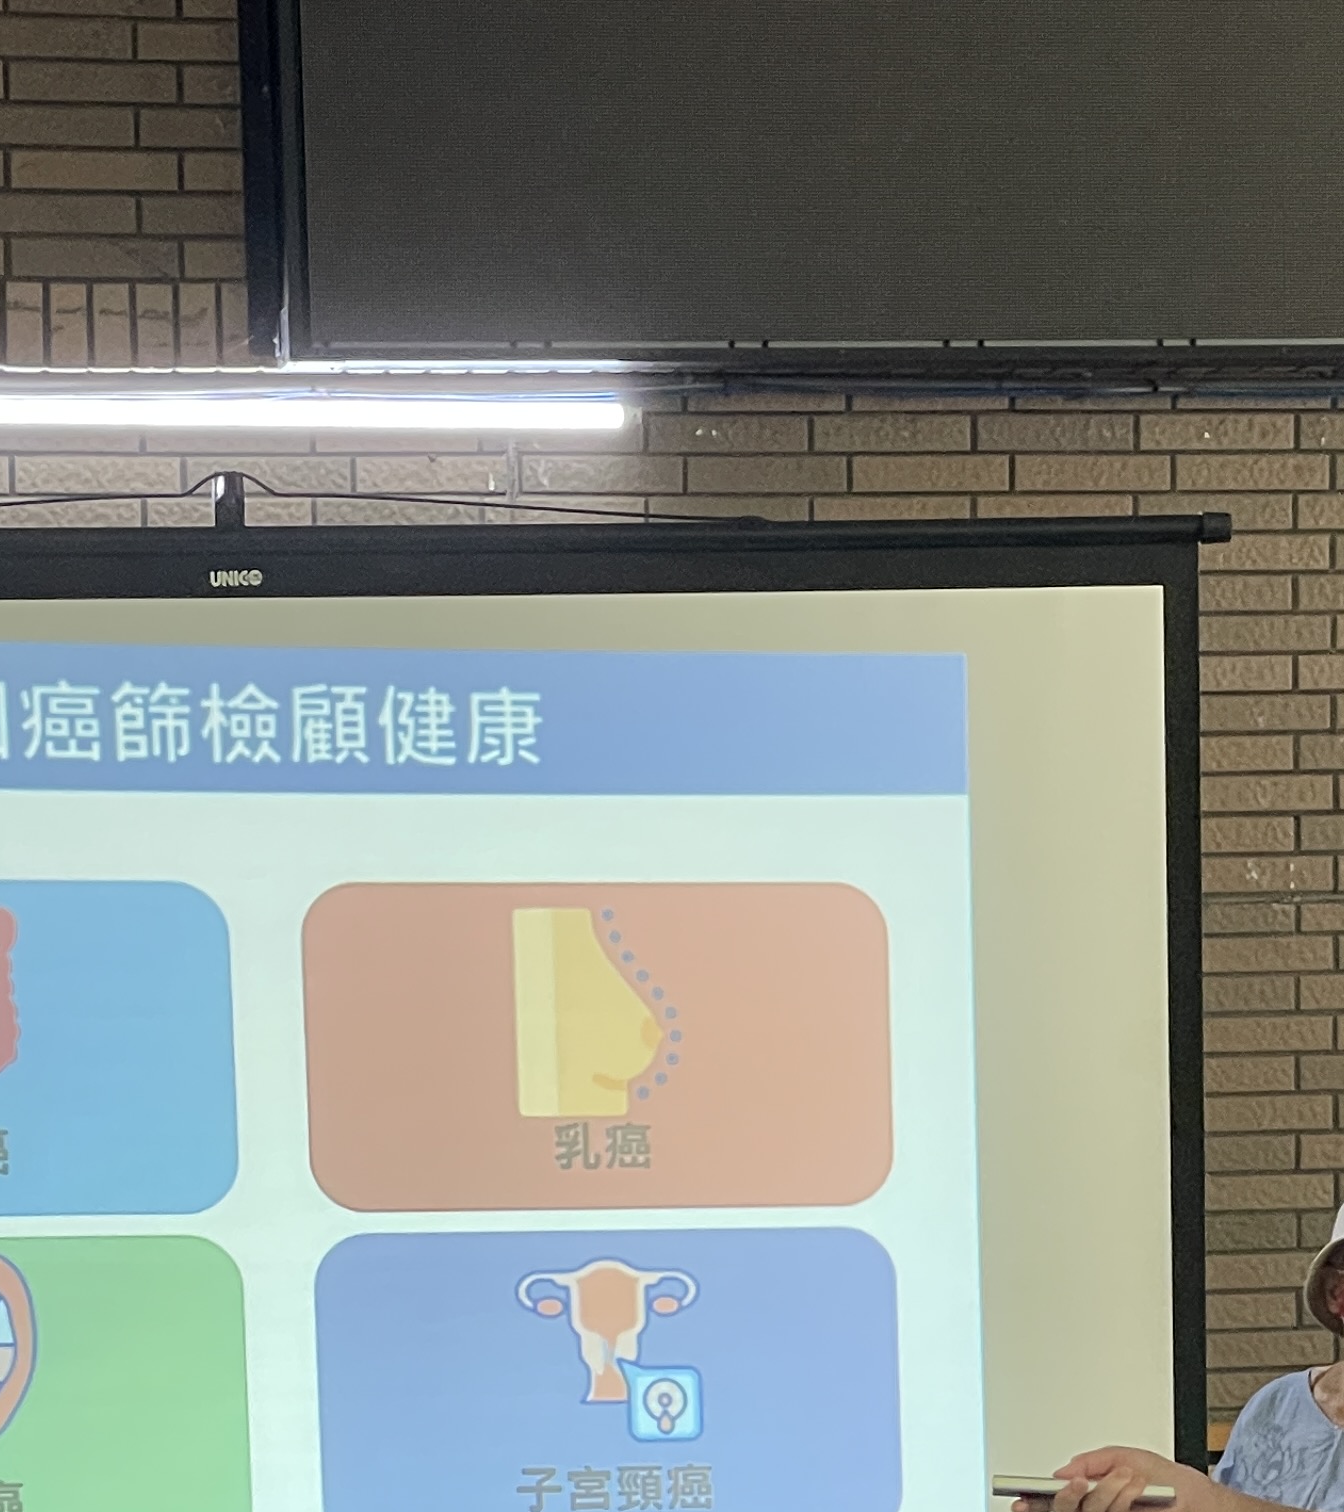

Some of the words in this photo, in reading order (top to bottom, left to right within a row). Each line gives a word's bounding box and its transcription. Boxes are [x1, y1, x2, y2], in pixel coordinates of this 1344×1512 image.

[554, 1121, 651, 1170] 乳癌
[516, 1463, 712, 1512] 子宮頸癌
